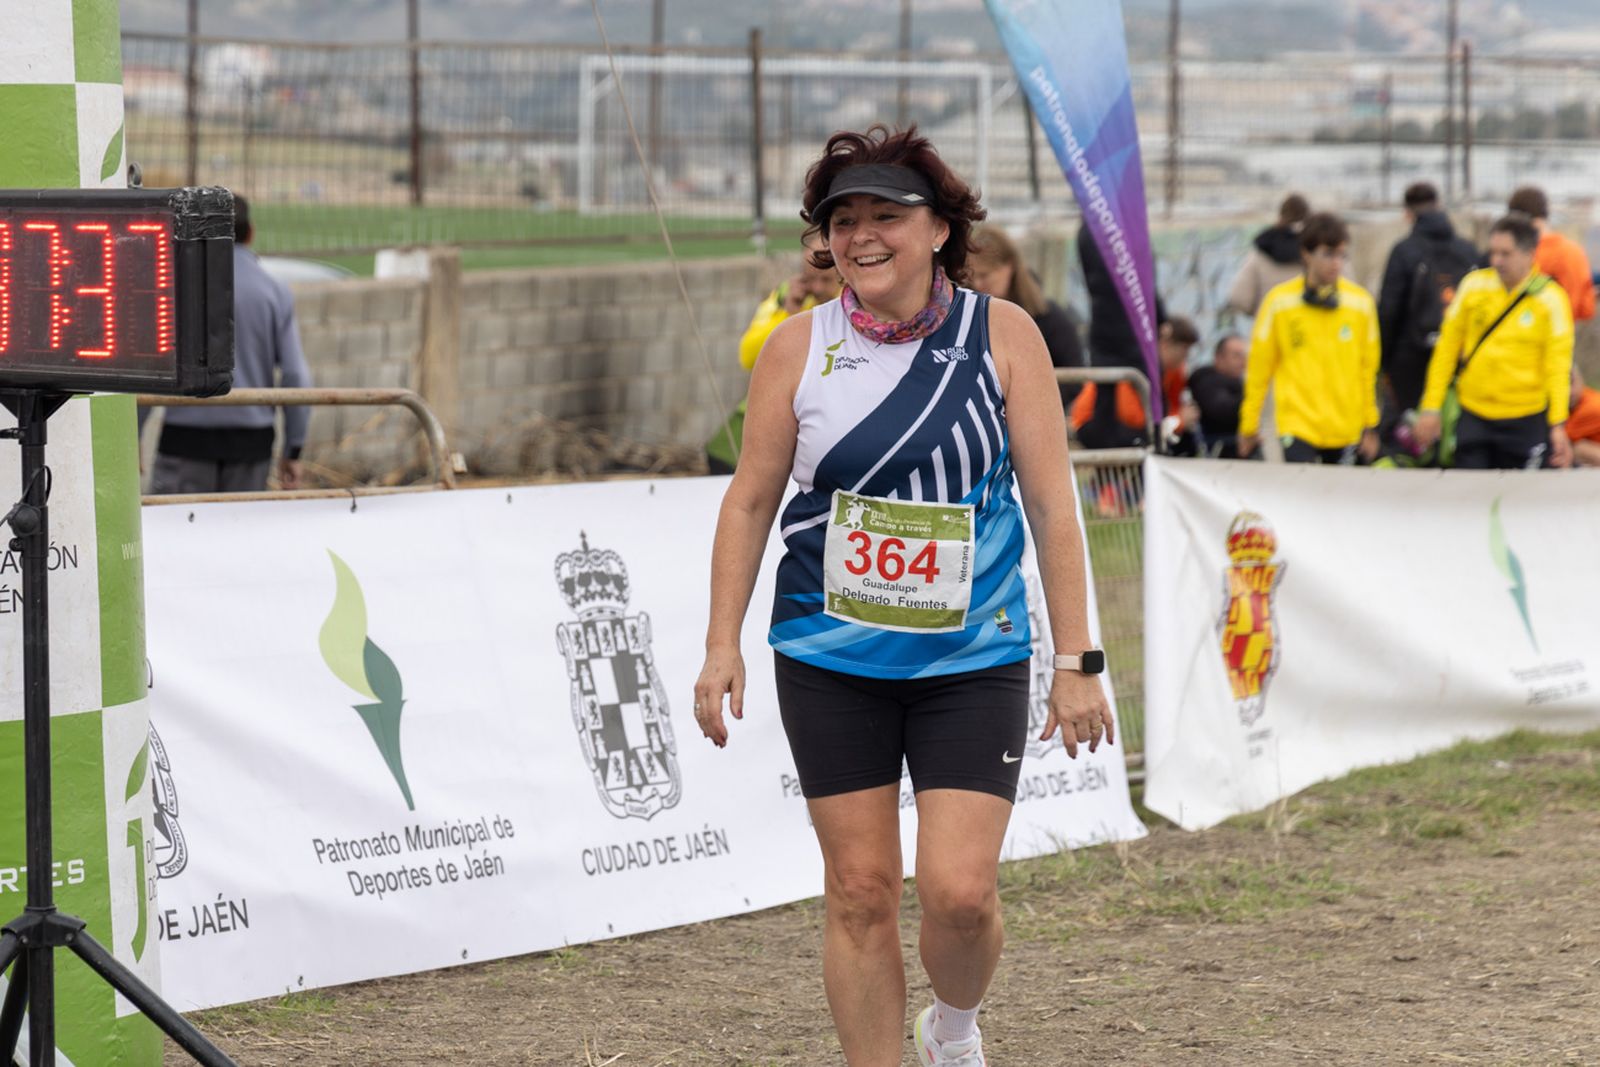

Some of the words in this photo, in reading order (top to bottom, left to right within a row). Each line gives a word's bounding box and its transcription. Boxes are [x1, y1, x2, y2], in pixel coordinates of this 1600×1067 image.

[869, 519, 896, 530] Campo
[906, 524, 932, 533] través
[844, 530, 940, 584] 364
[958, 545, 970, 583] Veterana
[842, 586, 890, 606] Delgado
[897, 597, 948, 610] Fuentes
[862, 578, 918, 593] Guadalupe
[1047, 771, 1073, 796] DE
[312, 830, 401, 864] Patronato
[404, 816, 491, 851] Municipal
[492, 814, 515, 839] de
[582, 840, 651, 876] CIUDAD
[653, 836, 680, 865] DE
[684, 823, 731, 861] JAÉN
[346, 864, 432, 900] Deportes
[435, 858, 459, 884] de
[464, 849, 505, 880] Jaén
[188, 893, 250, 938] JAÉN
